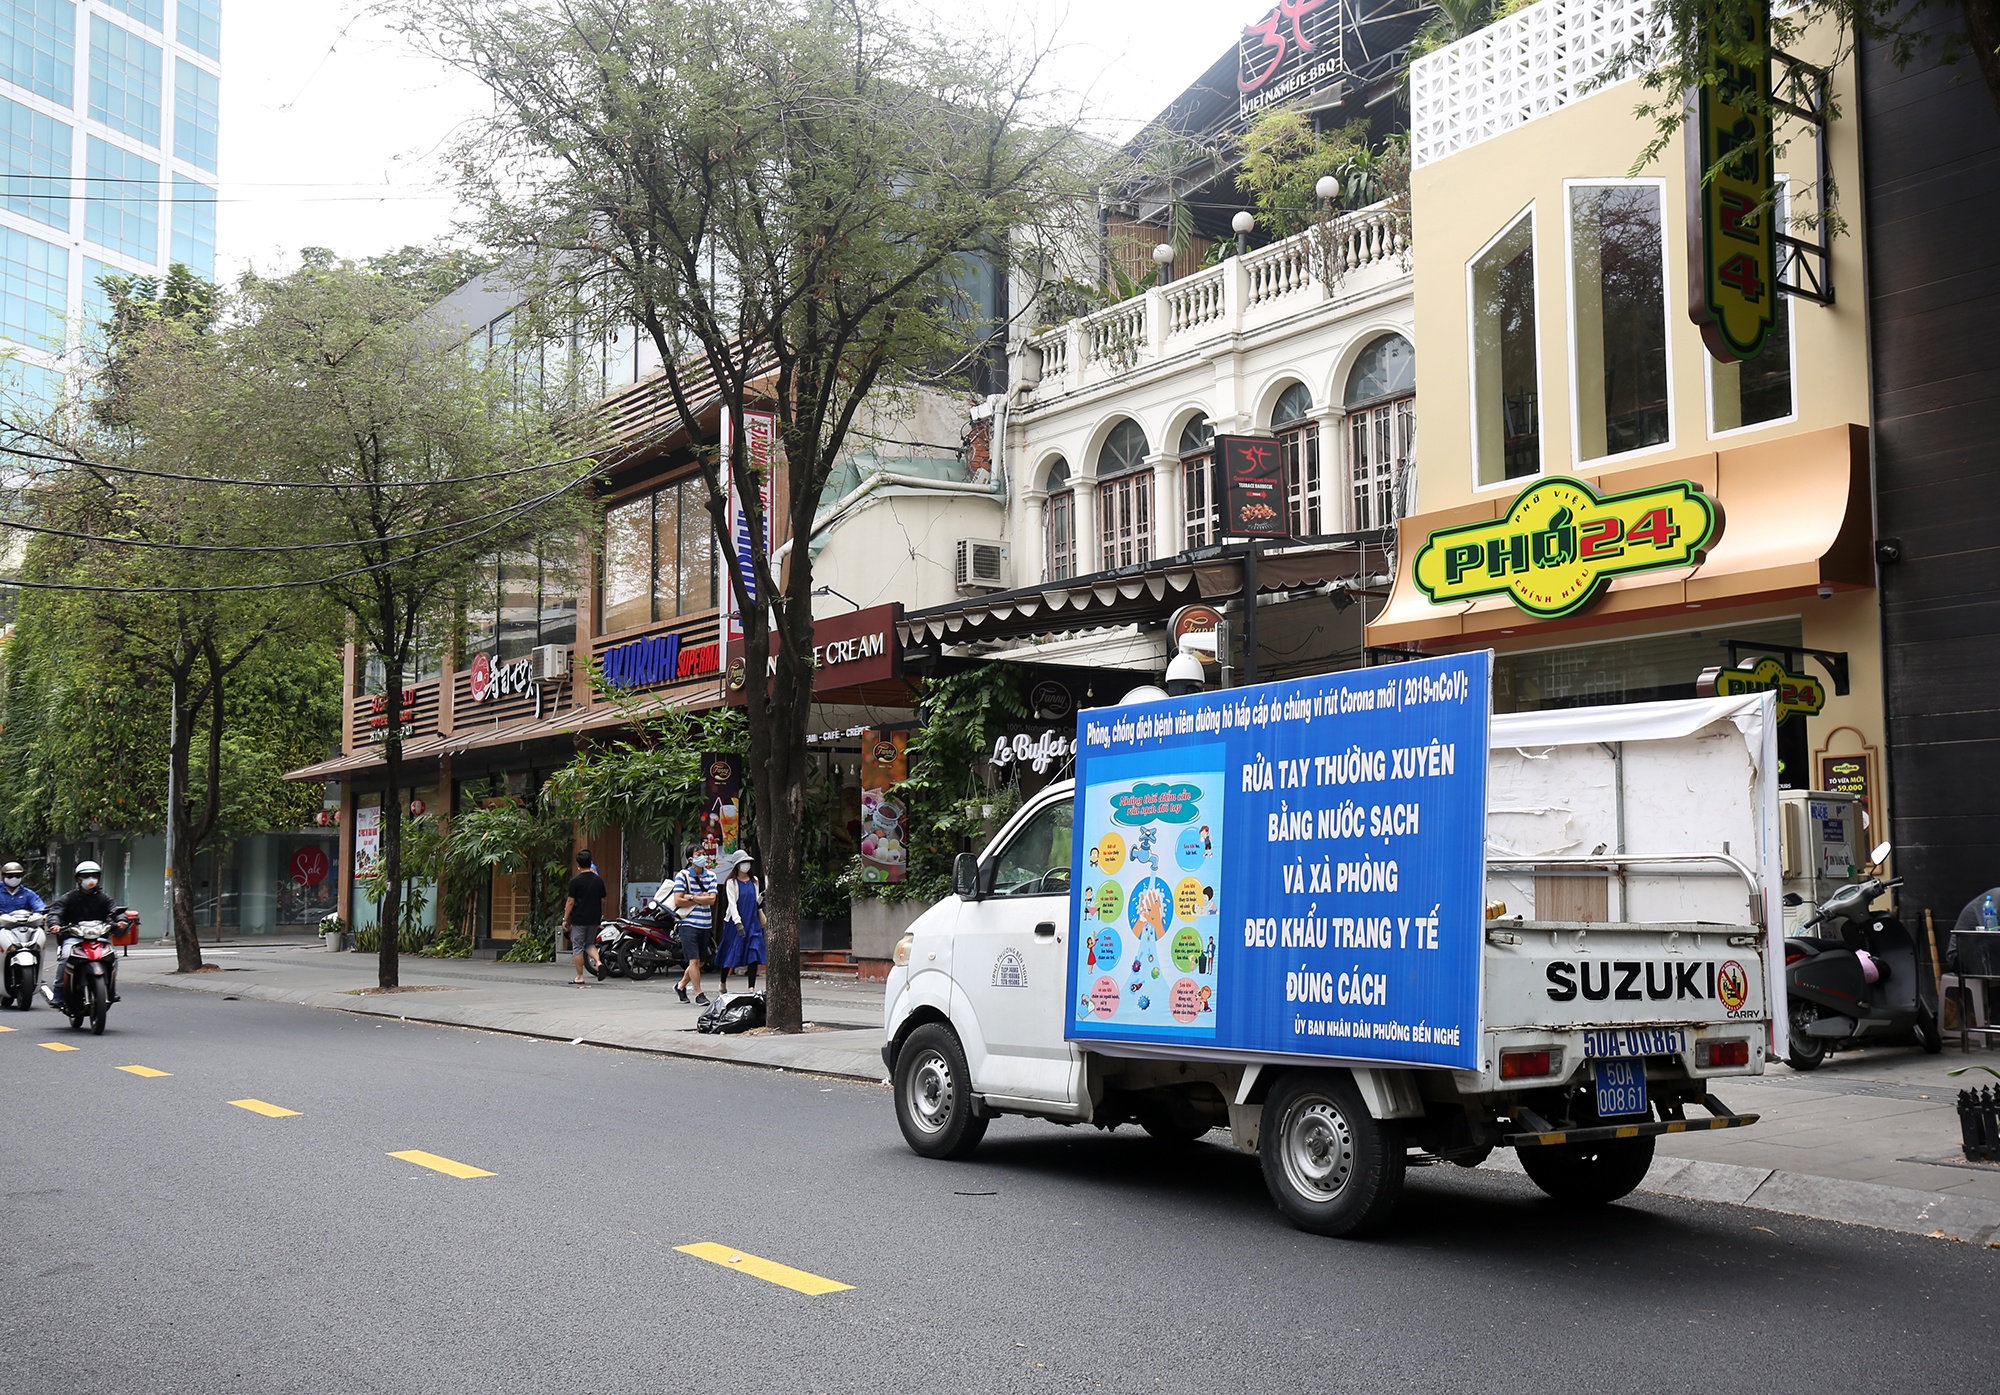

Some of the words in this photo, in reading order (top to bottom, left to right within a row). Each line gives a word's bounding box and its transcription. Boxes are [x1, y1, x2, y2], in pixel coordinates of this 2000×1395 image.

[1310, 58, 1336, 82] BBQ
[1554, 490, 1586, 511] VIỆT
[1561, 568, 1589, 599] HIỆU
[826, 632, 884, 665] CREAM
[1035, 687, 1068, 709] Fanny
[1086, 719, 1110, 749] Phòng,
[1112, 714, 1135, 745] chống
[1136, 715, 1152, 746] dịch
[1154, 712, 1174, 744] bệnh
[1175, 710, 1193, 734] viêm
[1195, 705, 1221, 735] đường
[1222, 703, 1233, 728] hô
[1234, 696, 1250, 731] hấp
[1252, 694, 1268, 729] cấp
[1270, 697, 1282, 723] do
[1283, 690, 1312, 724] chủng
[1313, 690, 1323, 717] vi
[1324, 688, 1338, 716] rút
[1340, 686, 1374, 714] Corona
[1376, 680, 1396, 709] mới
[823, 728, 840, 740] CAFÉ
[876, 744, 895, 759] Fanny
[989, 736, 1012, 766] Le
[1012, 730, 1066, 774] Buffet
[1242, 751, 1274, 792] RỬA
[1278, 758, 1310, 789] TAY
[1314, 745, 1386, 786] THƯỜNG
[1390, 737, 1455, 780] XUYÊN
[1268, 800, 1313, 842] BẰNG
[1317, 799, 1366, 839] NƯỚC
[1369, 803, 1419, 845] SẠCH
[292, 854, 320, 887] Sale
[1283, 856, 1304, 894] VÀ
[1308, 854, 1332, 893] XÀ
[1336, 852, 1398, 893] PHÒNG
[1245, 917, 1277, 948] ĐEO
[1281, 902, 1328, 948] KHẨU
[1332, 916, 1392, 949] TRANG
[1397, 917, 1410, 949] Y
[1415, 903, 1440, 950] TẾ
[1286, 963, 1333, 1004] ĐÚNG
[1337, 965, 1387, 1006] CÁCH
[1546, 961, 1716, 1002] SUZUKI
[1294, 1013, 1306, 1035] ỦY
[1308, 1020, 1325, 1036] BAN
[1326, 1018, 1351, 1038] NHÂN
[1353, 1019, 1371, 1039] DÂN
[1373, 1020, 1410, 1042] PHƯỜNG
[1412, 1020, 1431, 1044] BẾN
[1434, 1024, 1460, 1046] NGHÉ
[1726, 1010, 1760, 1018] CARRY
[1584, 1029, 1686, 1058] 50A-00861
[1606, 1062, 1634, 1086] 50A
[1599, 1086, 1643, 1112] 008.61
